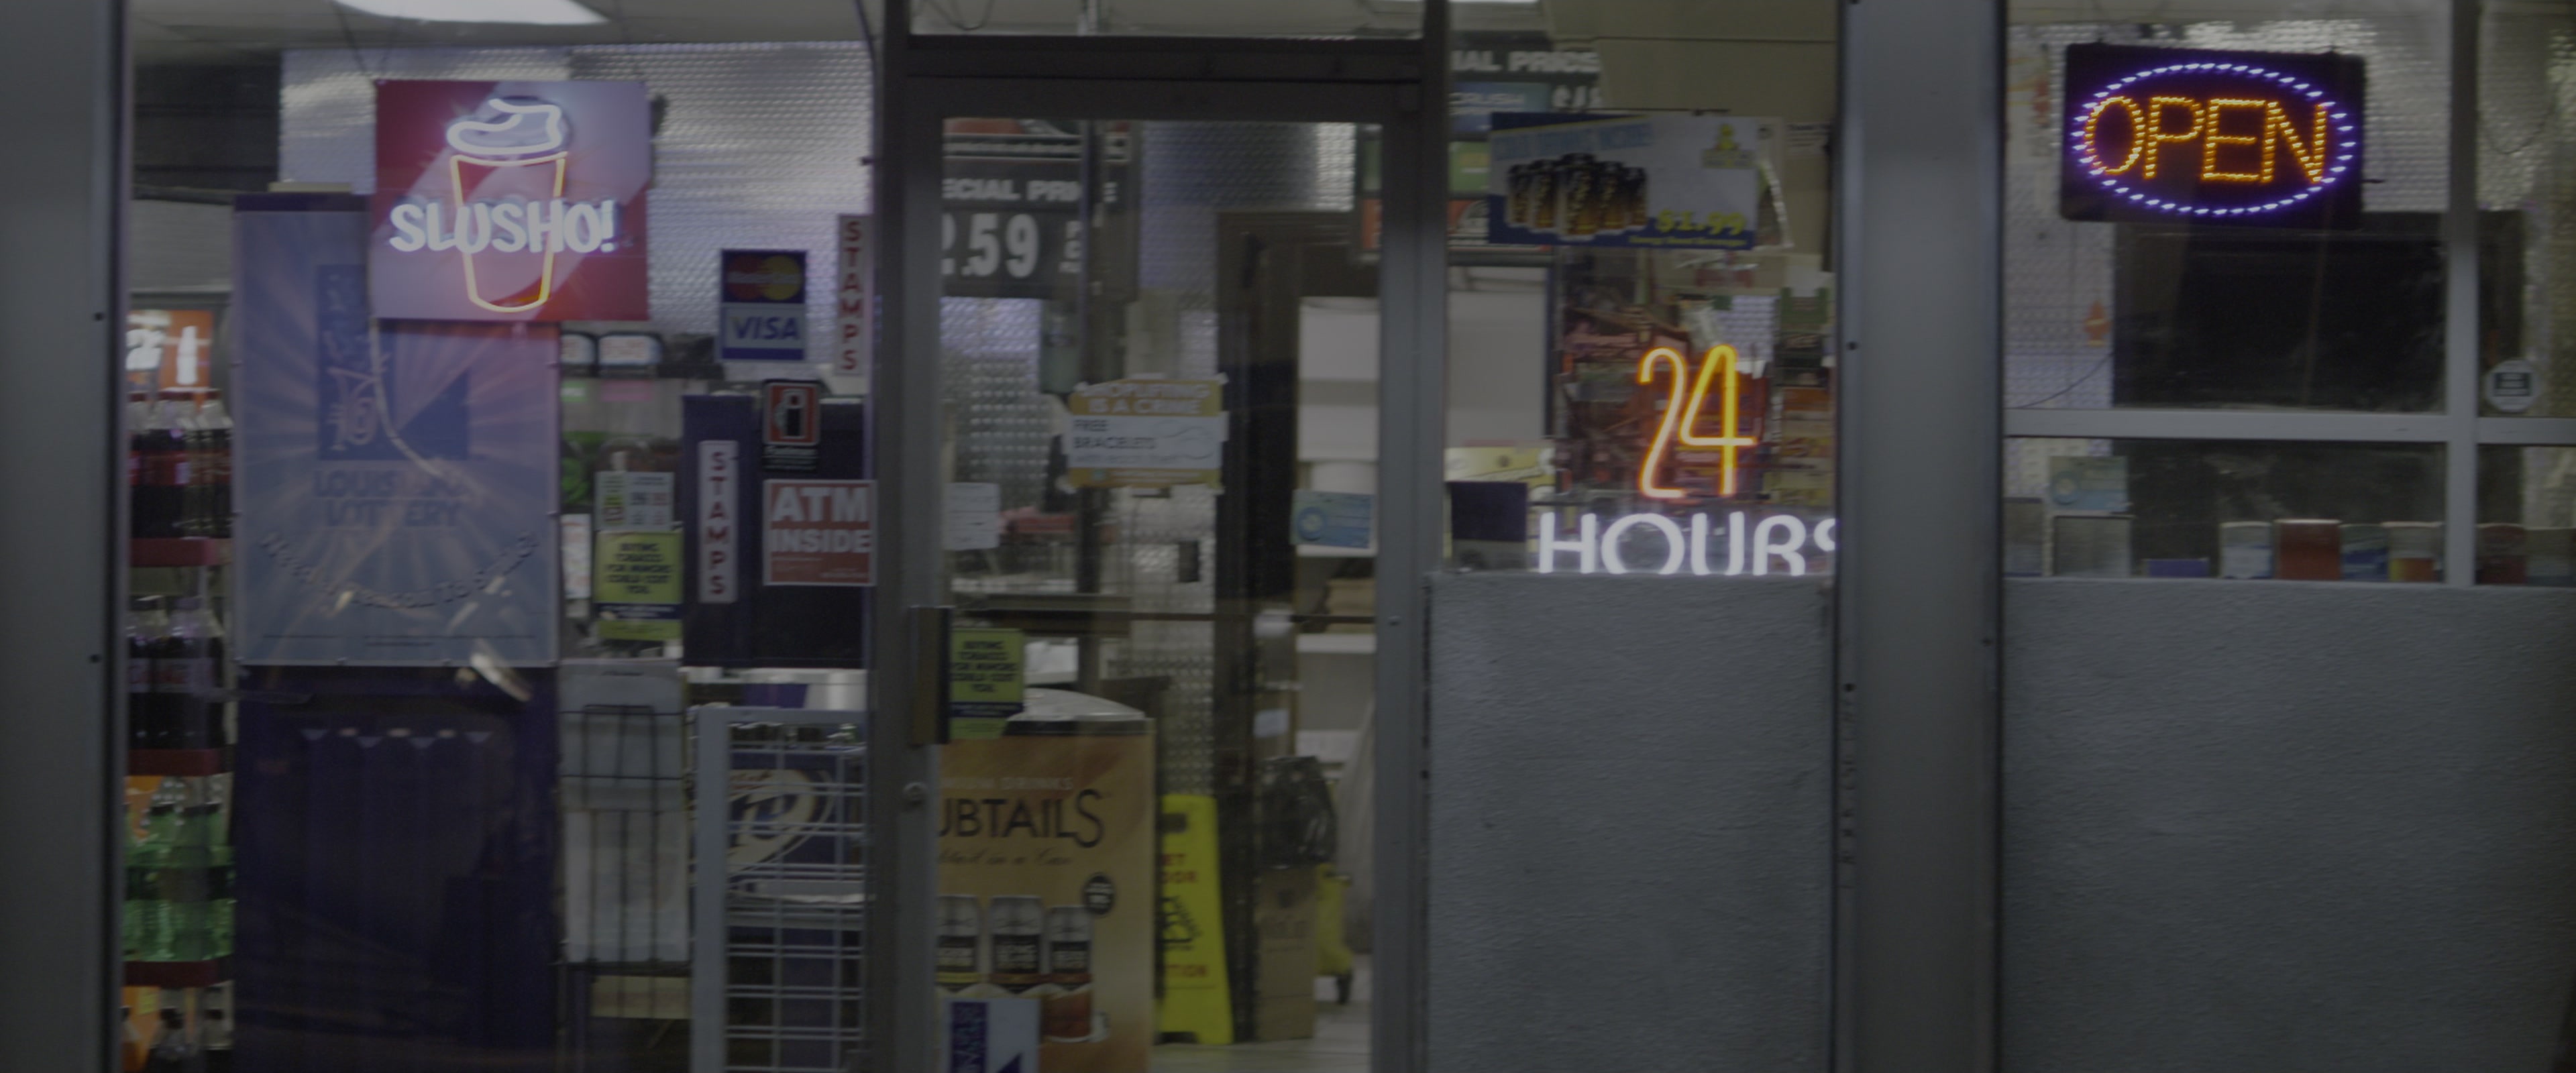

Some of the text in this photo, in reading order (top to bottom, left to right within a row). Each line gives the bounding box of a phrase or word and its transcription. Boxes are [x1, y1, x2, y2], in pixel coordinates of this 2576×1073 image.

[2084, 95, 2329, 184] OPEN
[1026, 179, 1118, 204] PRIE
[389, 199, 619, 254] SLUSHO!
[841, 219, 862, 372] STAMPS
[730, 316, 802, 341] VISA
[1073, 418, 1108, 433] FREE
[1635, 343, 1759, 498] 24
[1073, 436, 1157, 449] BRACELETS
[771, 485, 868, 522] ATM
[706, 451, 729, 595] STAMPS
[770, 528, 871, 553] INSIDE
